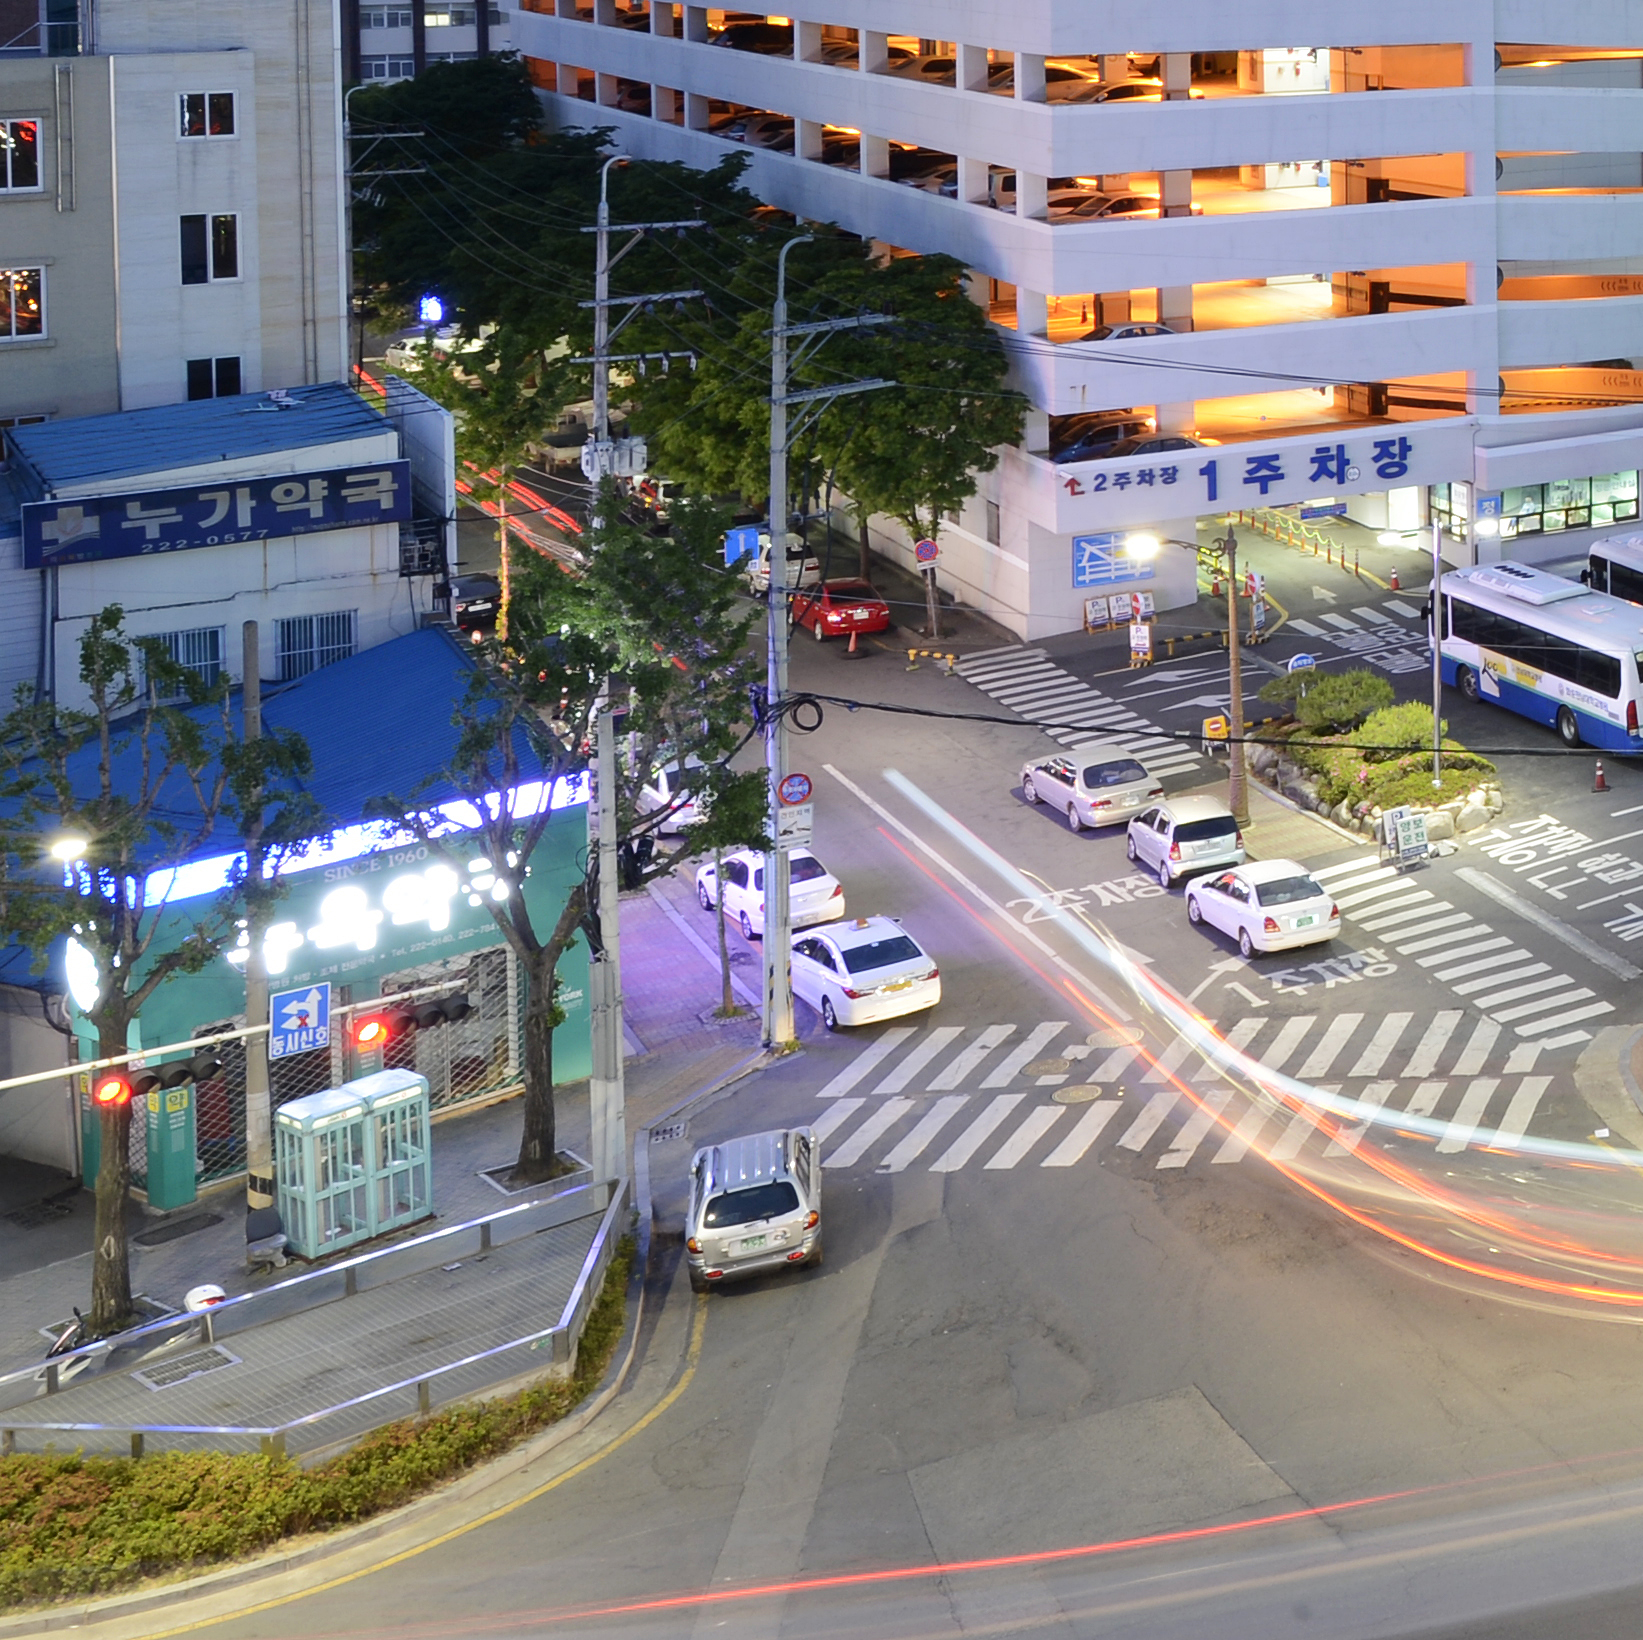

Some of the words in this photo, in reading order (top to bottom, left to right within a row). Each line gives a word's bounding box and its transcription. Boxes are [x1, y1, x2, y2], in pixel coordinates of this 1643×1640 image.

[1093, 465, 1179, 492] 2주차장
[121, 471, 399, 540] 누가약국
[141, 529, 269, 554] 222-0577
[323, 858, 382, 883] SINCE
[387, 846, 429, 868] 1960
[271, 1027, 327, 1055] 동시신호
